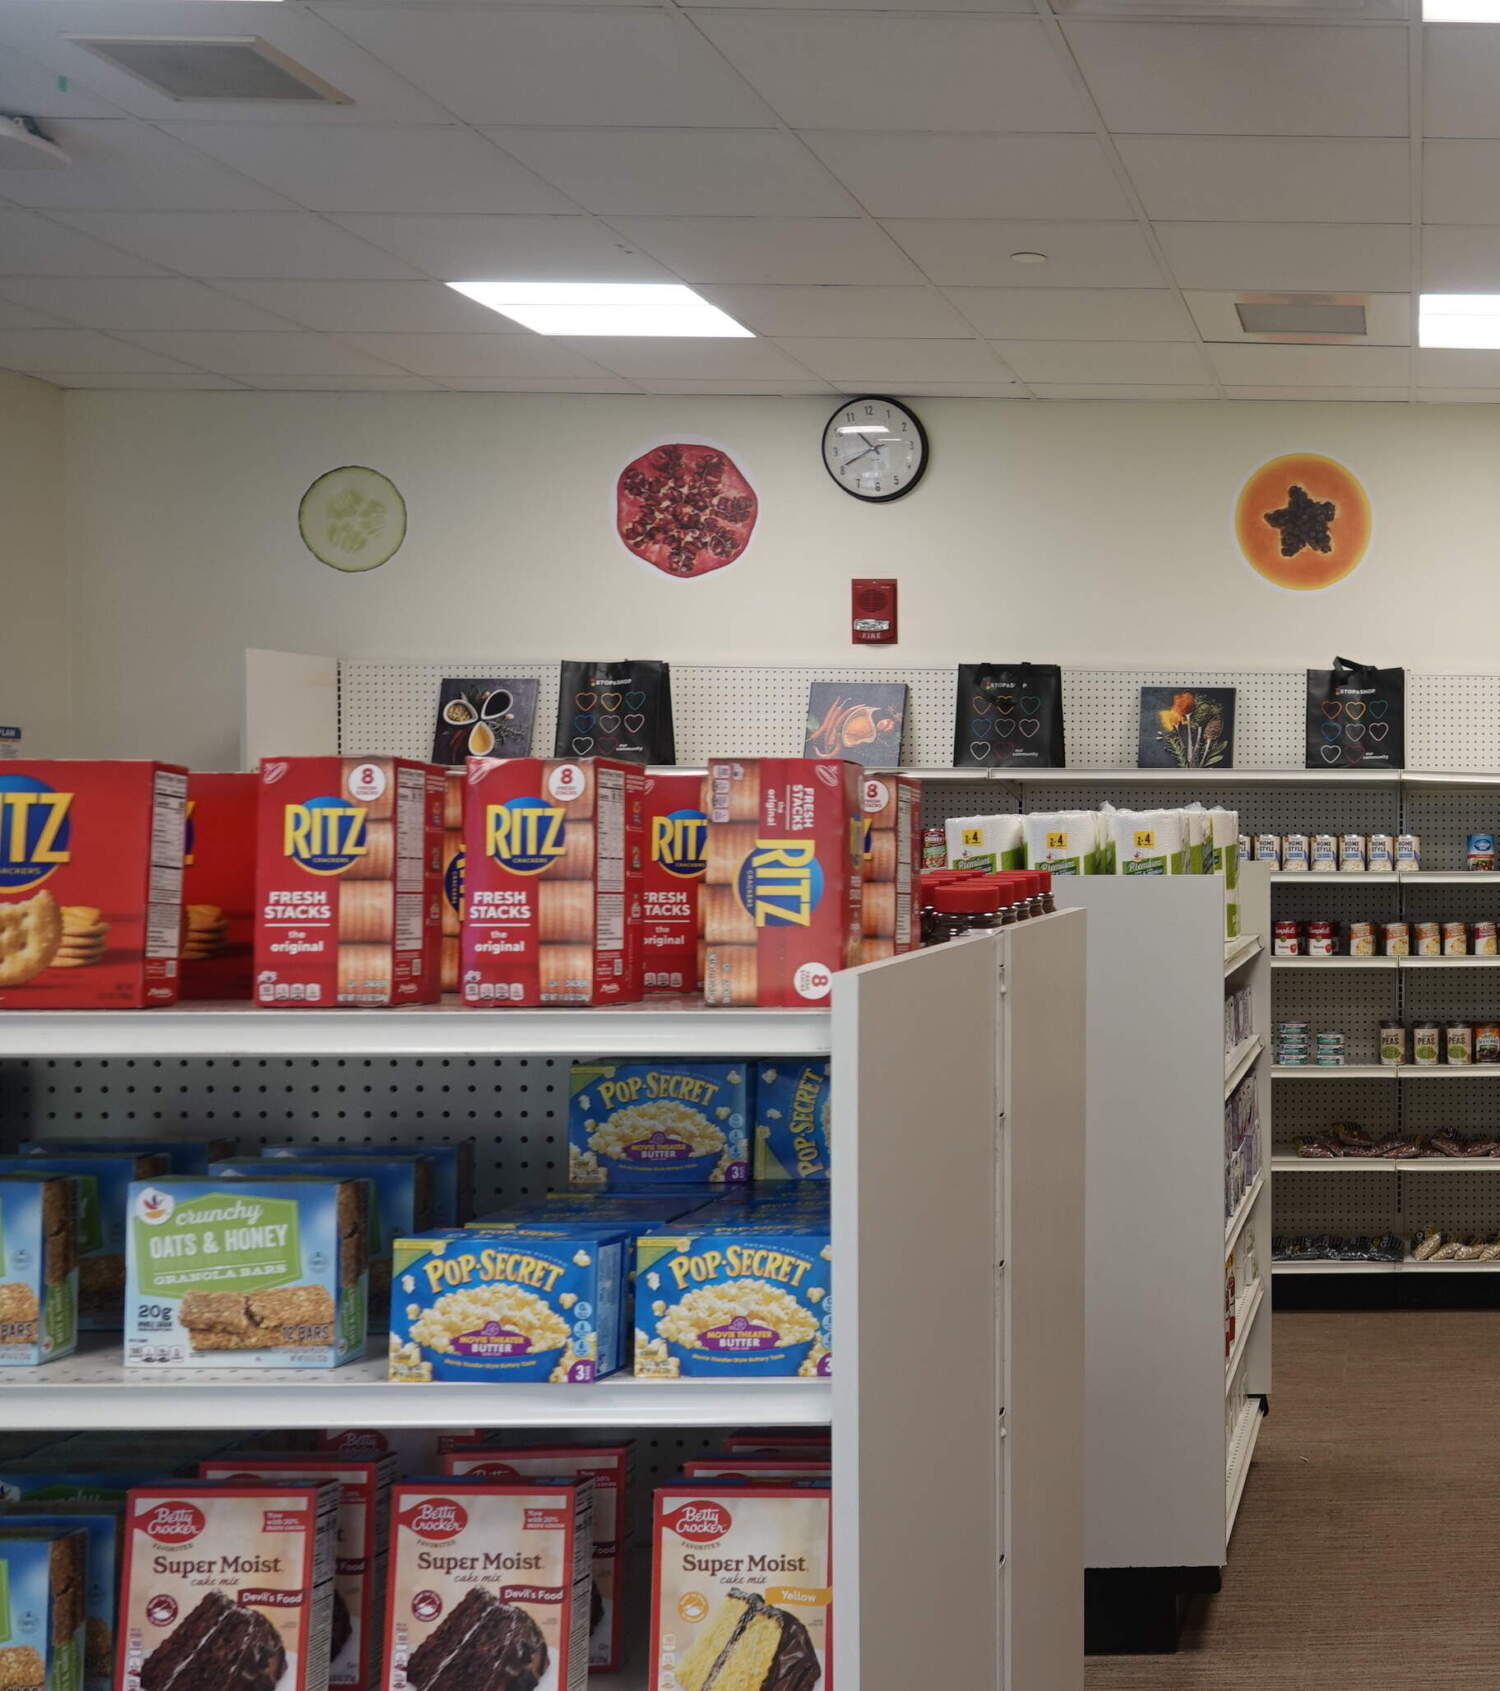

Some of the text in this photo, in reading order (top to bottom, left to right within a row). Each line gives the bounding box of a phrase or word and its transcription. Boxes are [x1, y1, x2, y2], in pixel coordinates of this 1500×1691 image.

[360, 768, 375, 784] 8
[559, 768, 573, 784] 8
[865, 782, 879, 799] 8
[767, 788, 777, 827] original
[791, 783, 804, 832] STACKS
[803, 786, 816, 830] FRESH
[284, 803, 369, 859] RITZ
[486, 803, 567, 860] RITZ
[755, 838, 816, 928] RITZ
[268, 891, 327, 905] FRESH
[473, 891, 527, 905] FRESH
[264, 905, 332, 920] STACKS
[469, 905, 532, 920] STACKS
[288, 929, 307, 941] the
[490, 929, 508, 941] the
[655, 925, 671, 935] the
[270, 940, 325, 954] original
[474, 940, 525, 955] original
[811, 974, 829, 988] 8
[1381, 1036, 1400, 1046] PEAS
[1417, 1036, 1435, 1046] PEAS
[1448, 1036, 1466, 1046] PEAS
[597, 1070, 720, 1111] POP-SECRET
[789, 1068, 826, 1178] POP-SECRET
[640, 1149, 677, 1159] BUTTER
[174, 1199, 264, 1228] crunchy
[149, 1224, 289, 1260] OATS & HONEY
[153, 1262, 287, 1286] GRANOLA BARS
[422, 1248, 565, 1295] POP-SECRET
[668, 1244, 812, 1291] POP-SECRET
[137, 1304, 173, 1323] 20g
[1, 1322, 33, 1339] BARS
[281, 1324, 330, 1341] 12 BARS
[470, 1343, 512, 1355] BUTTER
[719, 1337, 761, 1349] BUTTER
[575, 1364, 585, 1382] 3
[154, 1506, 193, 1526] Betty
[420, 1504, 457, 1523] Betty
[683, 1505, 720, 1524] Betty
[147, 1519, 200, 1537] Crocker
[411, 1517, 463, 1533] Crocker
[675, 1518, 727, 1535] Crocker
[153, 1555, 282, 1580] Super Moist
[417, 1551, 543, 1576] Super Moist
[682, 1554, 807, 1578] Super Moist
[190, 1577, 240, 1587] cake mix
[453, 1574, 502, 1583] cake mix
[719, 1575, 767, 1585] cake mix
[242, 1591, 304, 1606] Devil's Food
[504, 1587, 564, 1602] Devil's Food
[781, 1589, 817, 1603] Yellow
